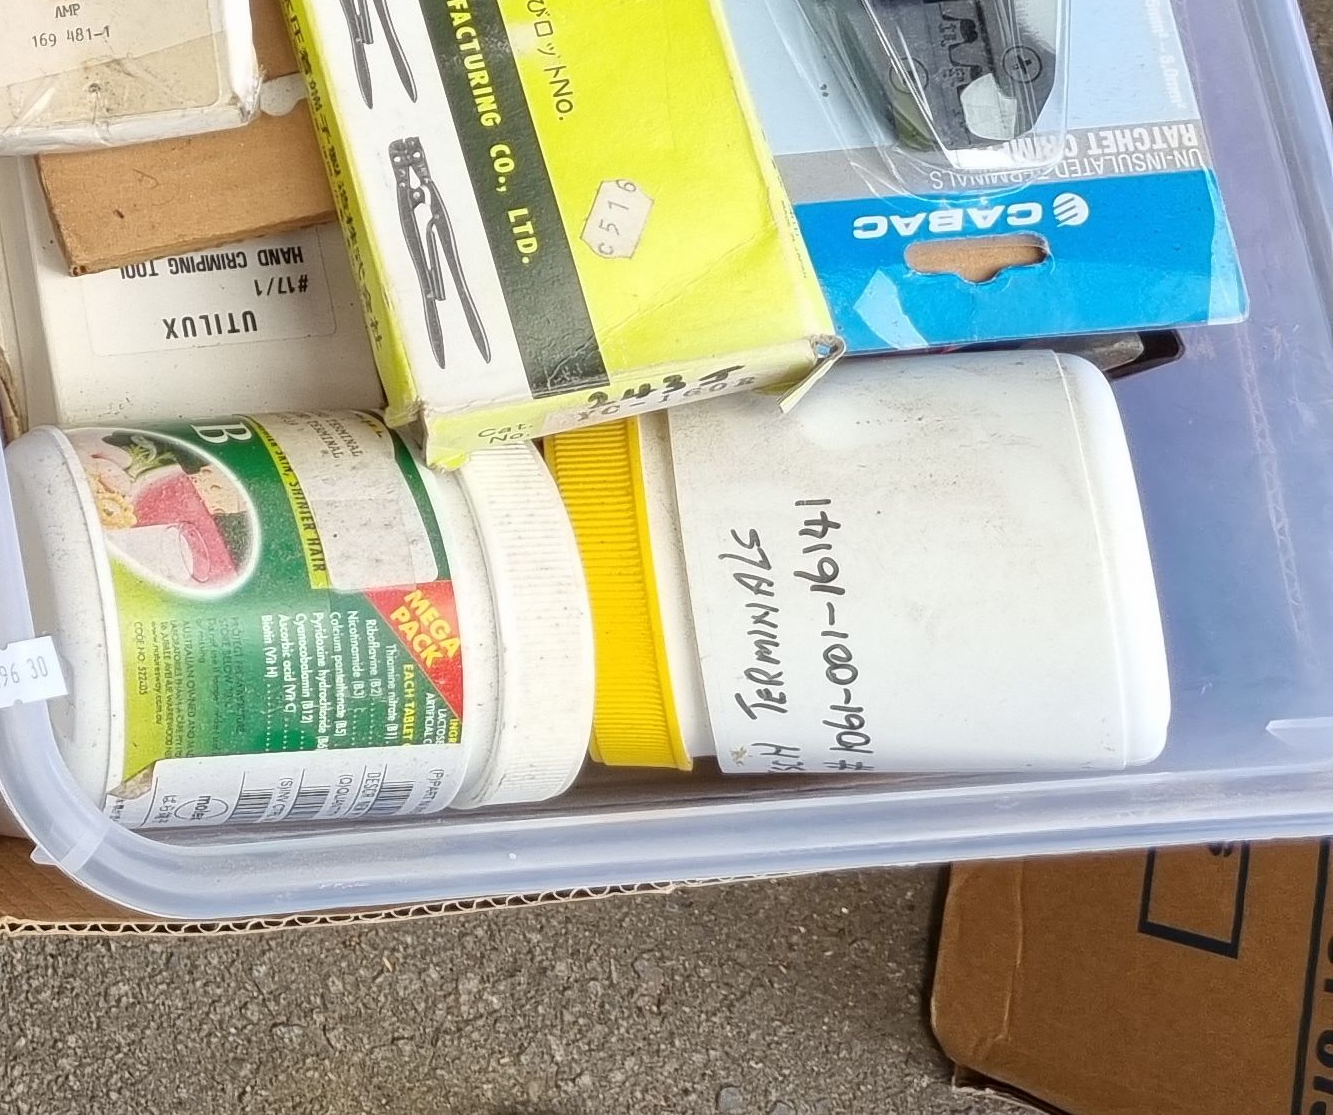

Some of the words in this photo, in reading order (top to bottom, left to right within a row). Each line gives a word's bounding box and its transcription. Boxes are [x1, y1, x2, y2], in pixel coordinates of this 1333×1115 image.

[54, 3, 82, 18] AMP
[31, 33, 58, 48] 169
[66, 26, 111, 43] 481-1
[1088, 123, 1199, 157] RATCHET
[1056, 146, 1205, 178] UN-INSULATED
[489, 141, 516, 192] CO.,
[508, 207, 539, 265] LTD.
[852, 201, 1043, 240] CABAC
[168, 251, 248, 276] CRIMPING
[257, 246, 304, 268] HAND
[254, 274, 309, 297] #17/1
[161, 310, 258, 340] UTILUX
[190, 422, 252, 443] B
[288, 481, 317, 531] SHINIER
[306, 537, 327, 572] HAIR
[261, 614, 274, 644] Biotin
[277, 613, 291, 660] Ascorbic
[312, 612, 327, 668] Pyridoxine
[329, 611, 342, 652] Calcium
[390, 606, 443, 667] PACK
[404, 589, 461, 659] MEGA
[719, 527, 789, 721] TERMINALS
[347, 610, 363, 678] Nicotinamide
[26, 655, 49, 679] 30
[402, 664, 416, 697] EACH
[351, 680, 366, 699] (B3)
[402, 701, 416, 740] TABLET
